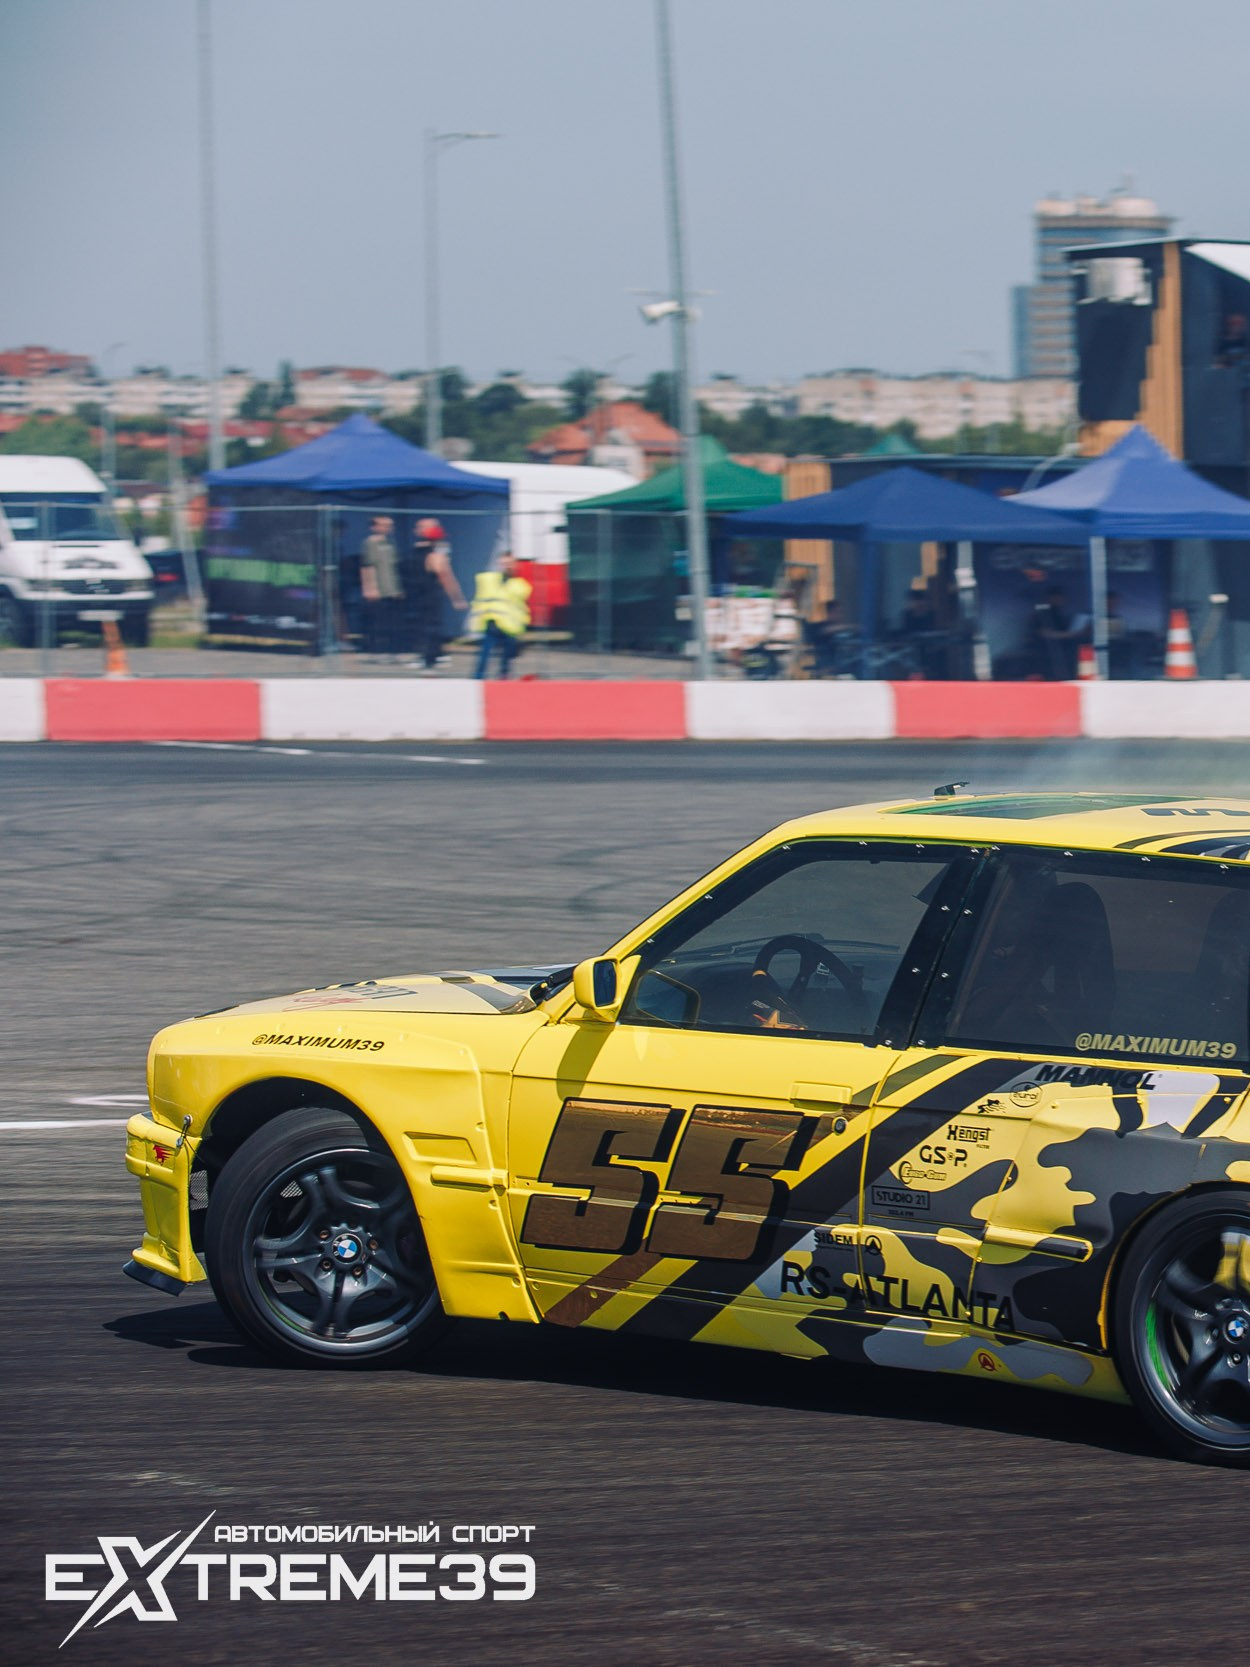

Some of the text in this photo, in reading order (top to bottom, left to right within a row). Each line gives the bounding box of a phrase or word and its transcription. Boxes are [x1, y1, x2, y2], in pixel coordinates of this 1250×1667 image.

[251, 1033, 385, 1052] @MAXIMUM39
[1075, 1032, 1237, 1059] @MAXIMUM39
[1035, 1064, 1156, 1091] MANNOL
[946, 1124, 992, 1143] Hengst
[520, 1096, 820, 1264] 55
[876, 1190, 926, 1206] STUDIO 21
[814, 1231, 853, 1245] SIDEM
[780, 1260, 1016, 1332] RS-ATLANTA
